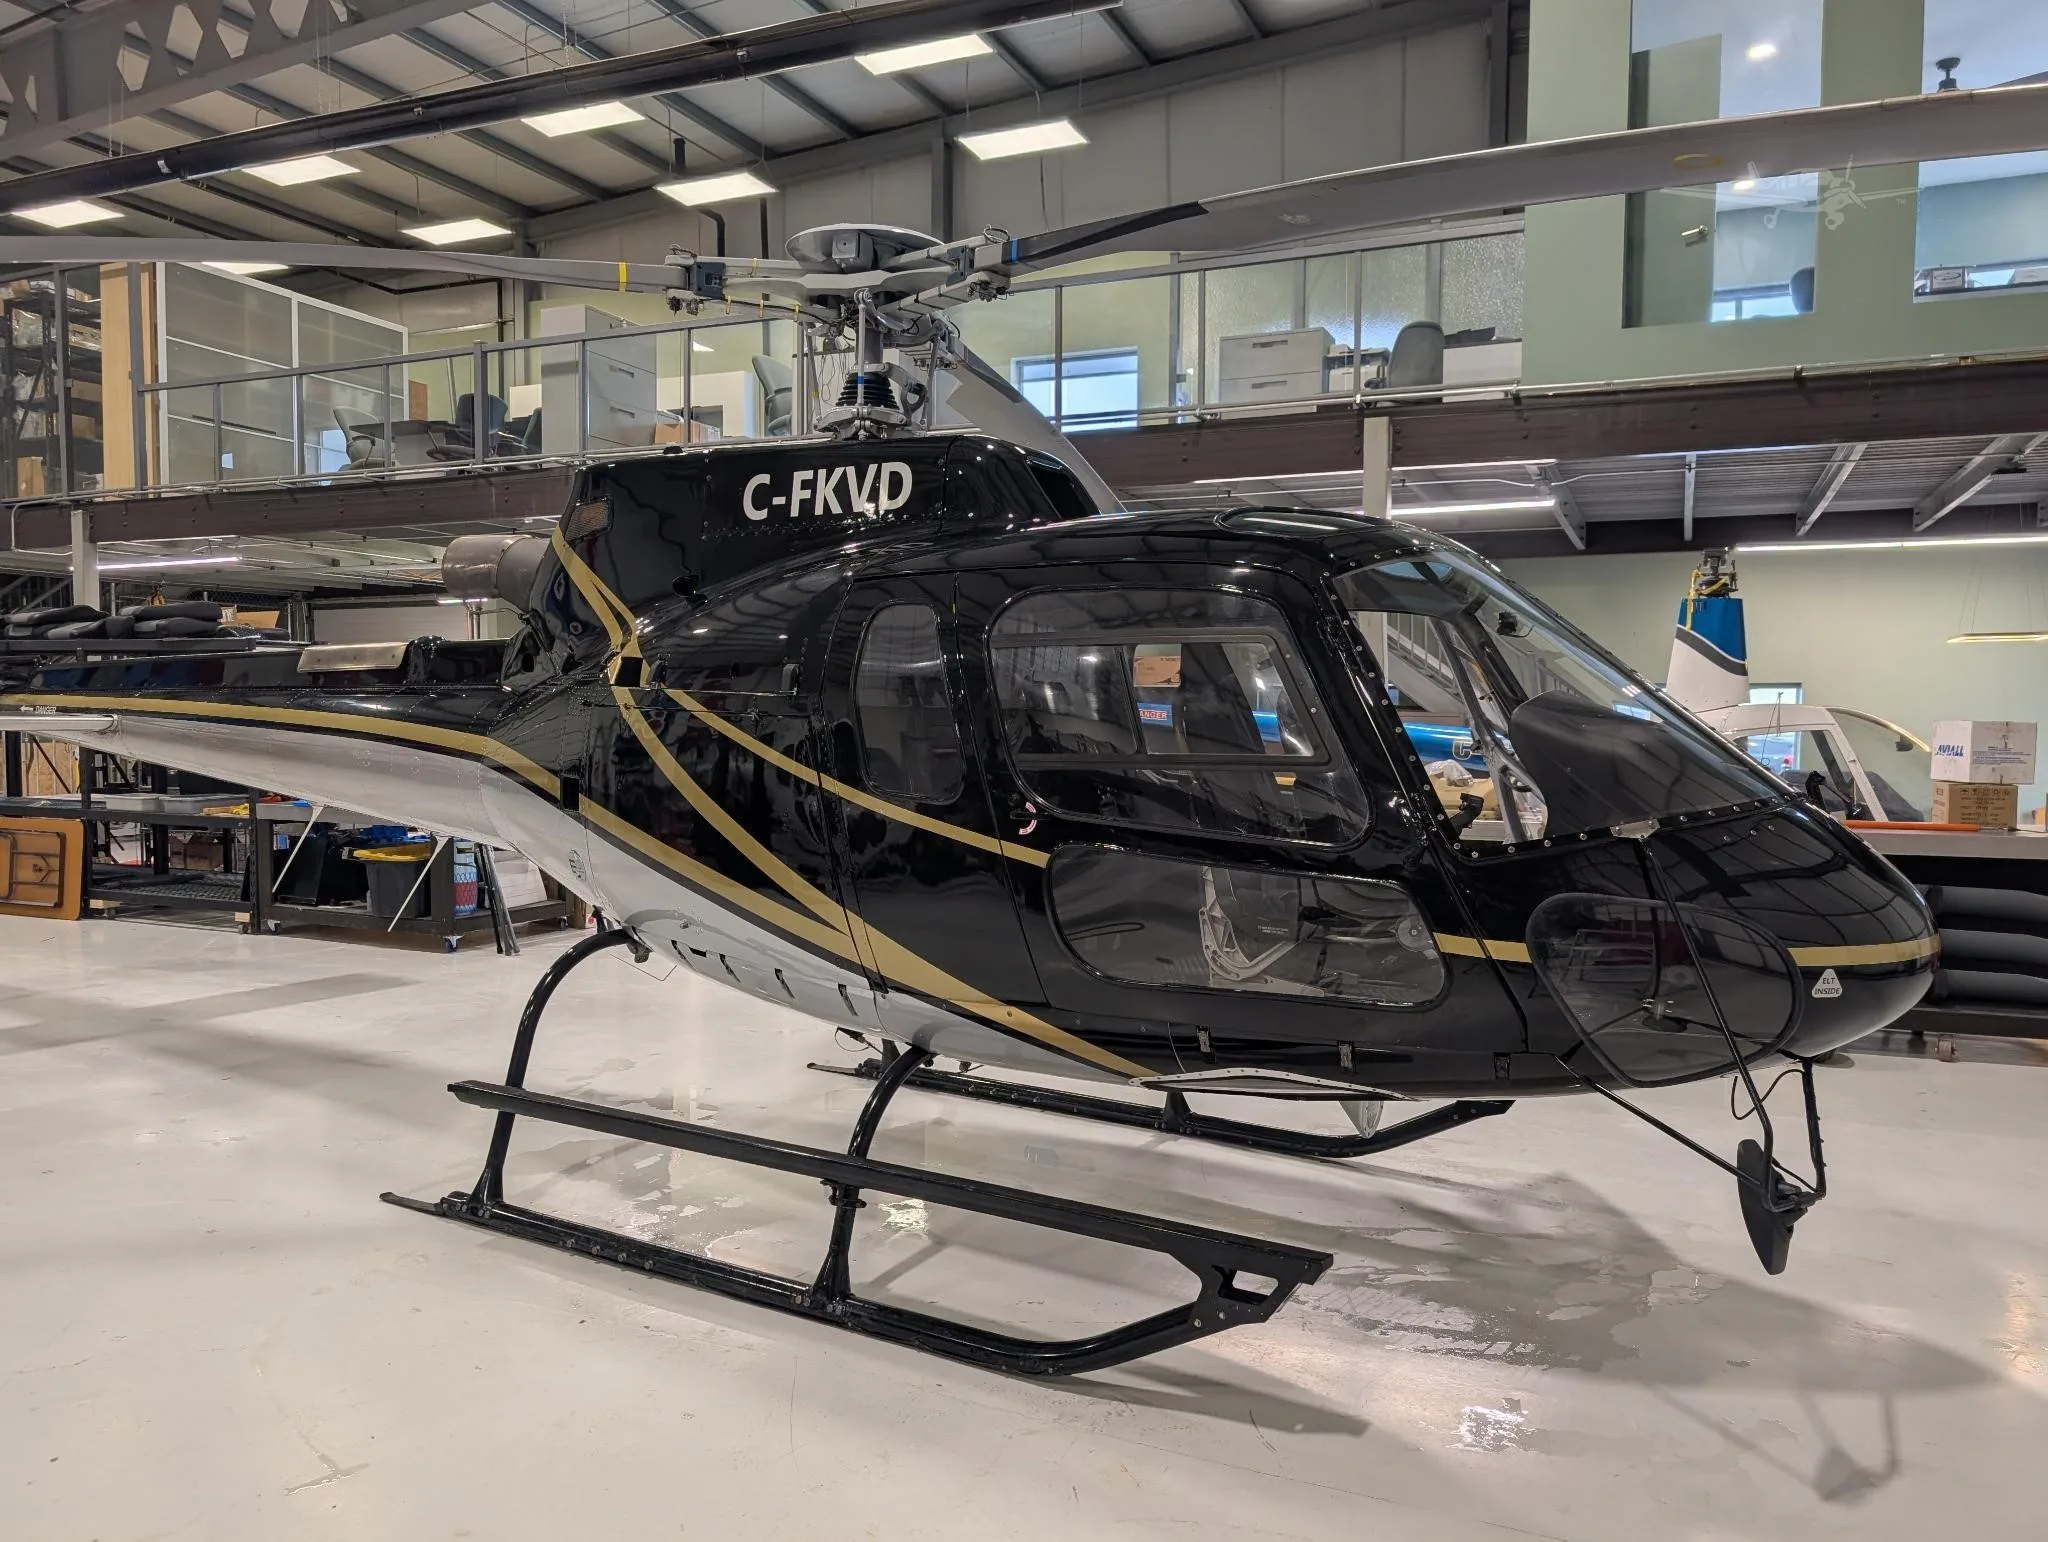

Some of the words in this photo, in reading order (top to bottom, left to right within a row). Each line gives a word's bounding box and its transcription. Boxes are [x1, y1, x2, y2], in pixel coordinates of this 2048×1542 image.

[742, 461, 913, 521] C-FKVD
[35, 706, 57, 715] DANGER
[1139, 710, 1167, 719] ANGER
[1936, 744, 1964, 757] AVIALL
[1822, 977, 1836, 985] ELT
[1814, 987, 1841, 995] INSIDE
